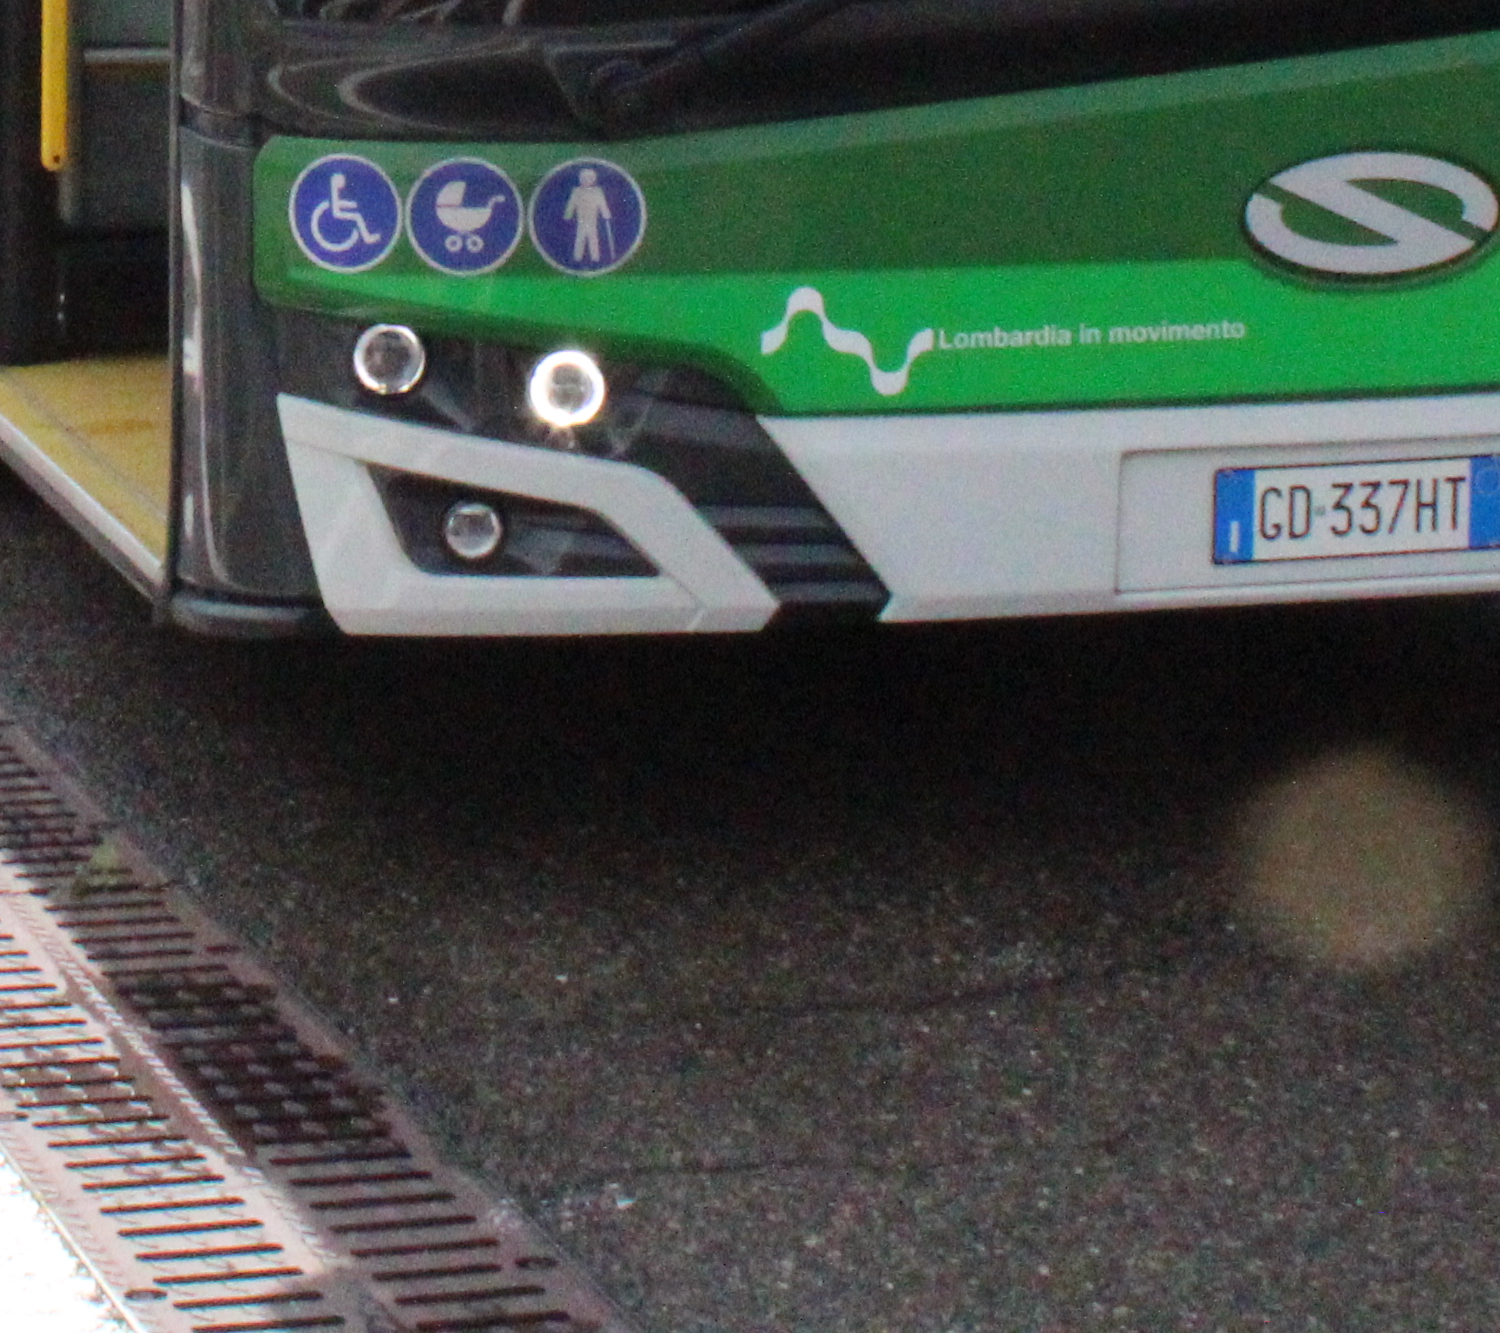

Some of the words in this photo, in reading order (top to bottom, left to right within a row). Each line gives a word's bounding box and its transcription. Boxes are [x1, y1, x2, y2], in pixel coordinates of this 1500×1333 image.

[939, 324, 1073, 350] Lombardia
[1079, 322, 1101, 345] in
[1108, 319, 1247, 344] movimento
